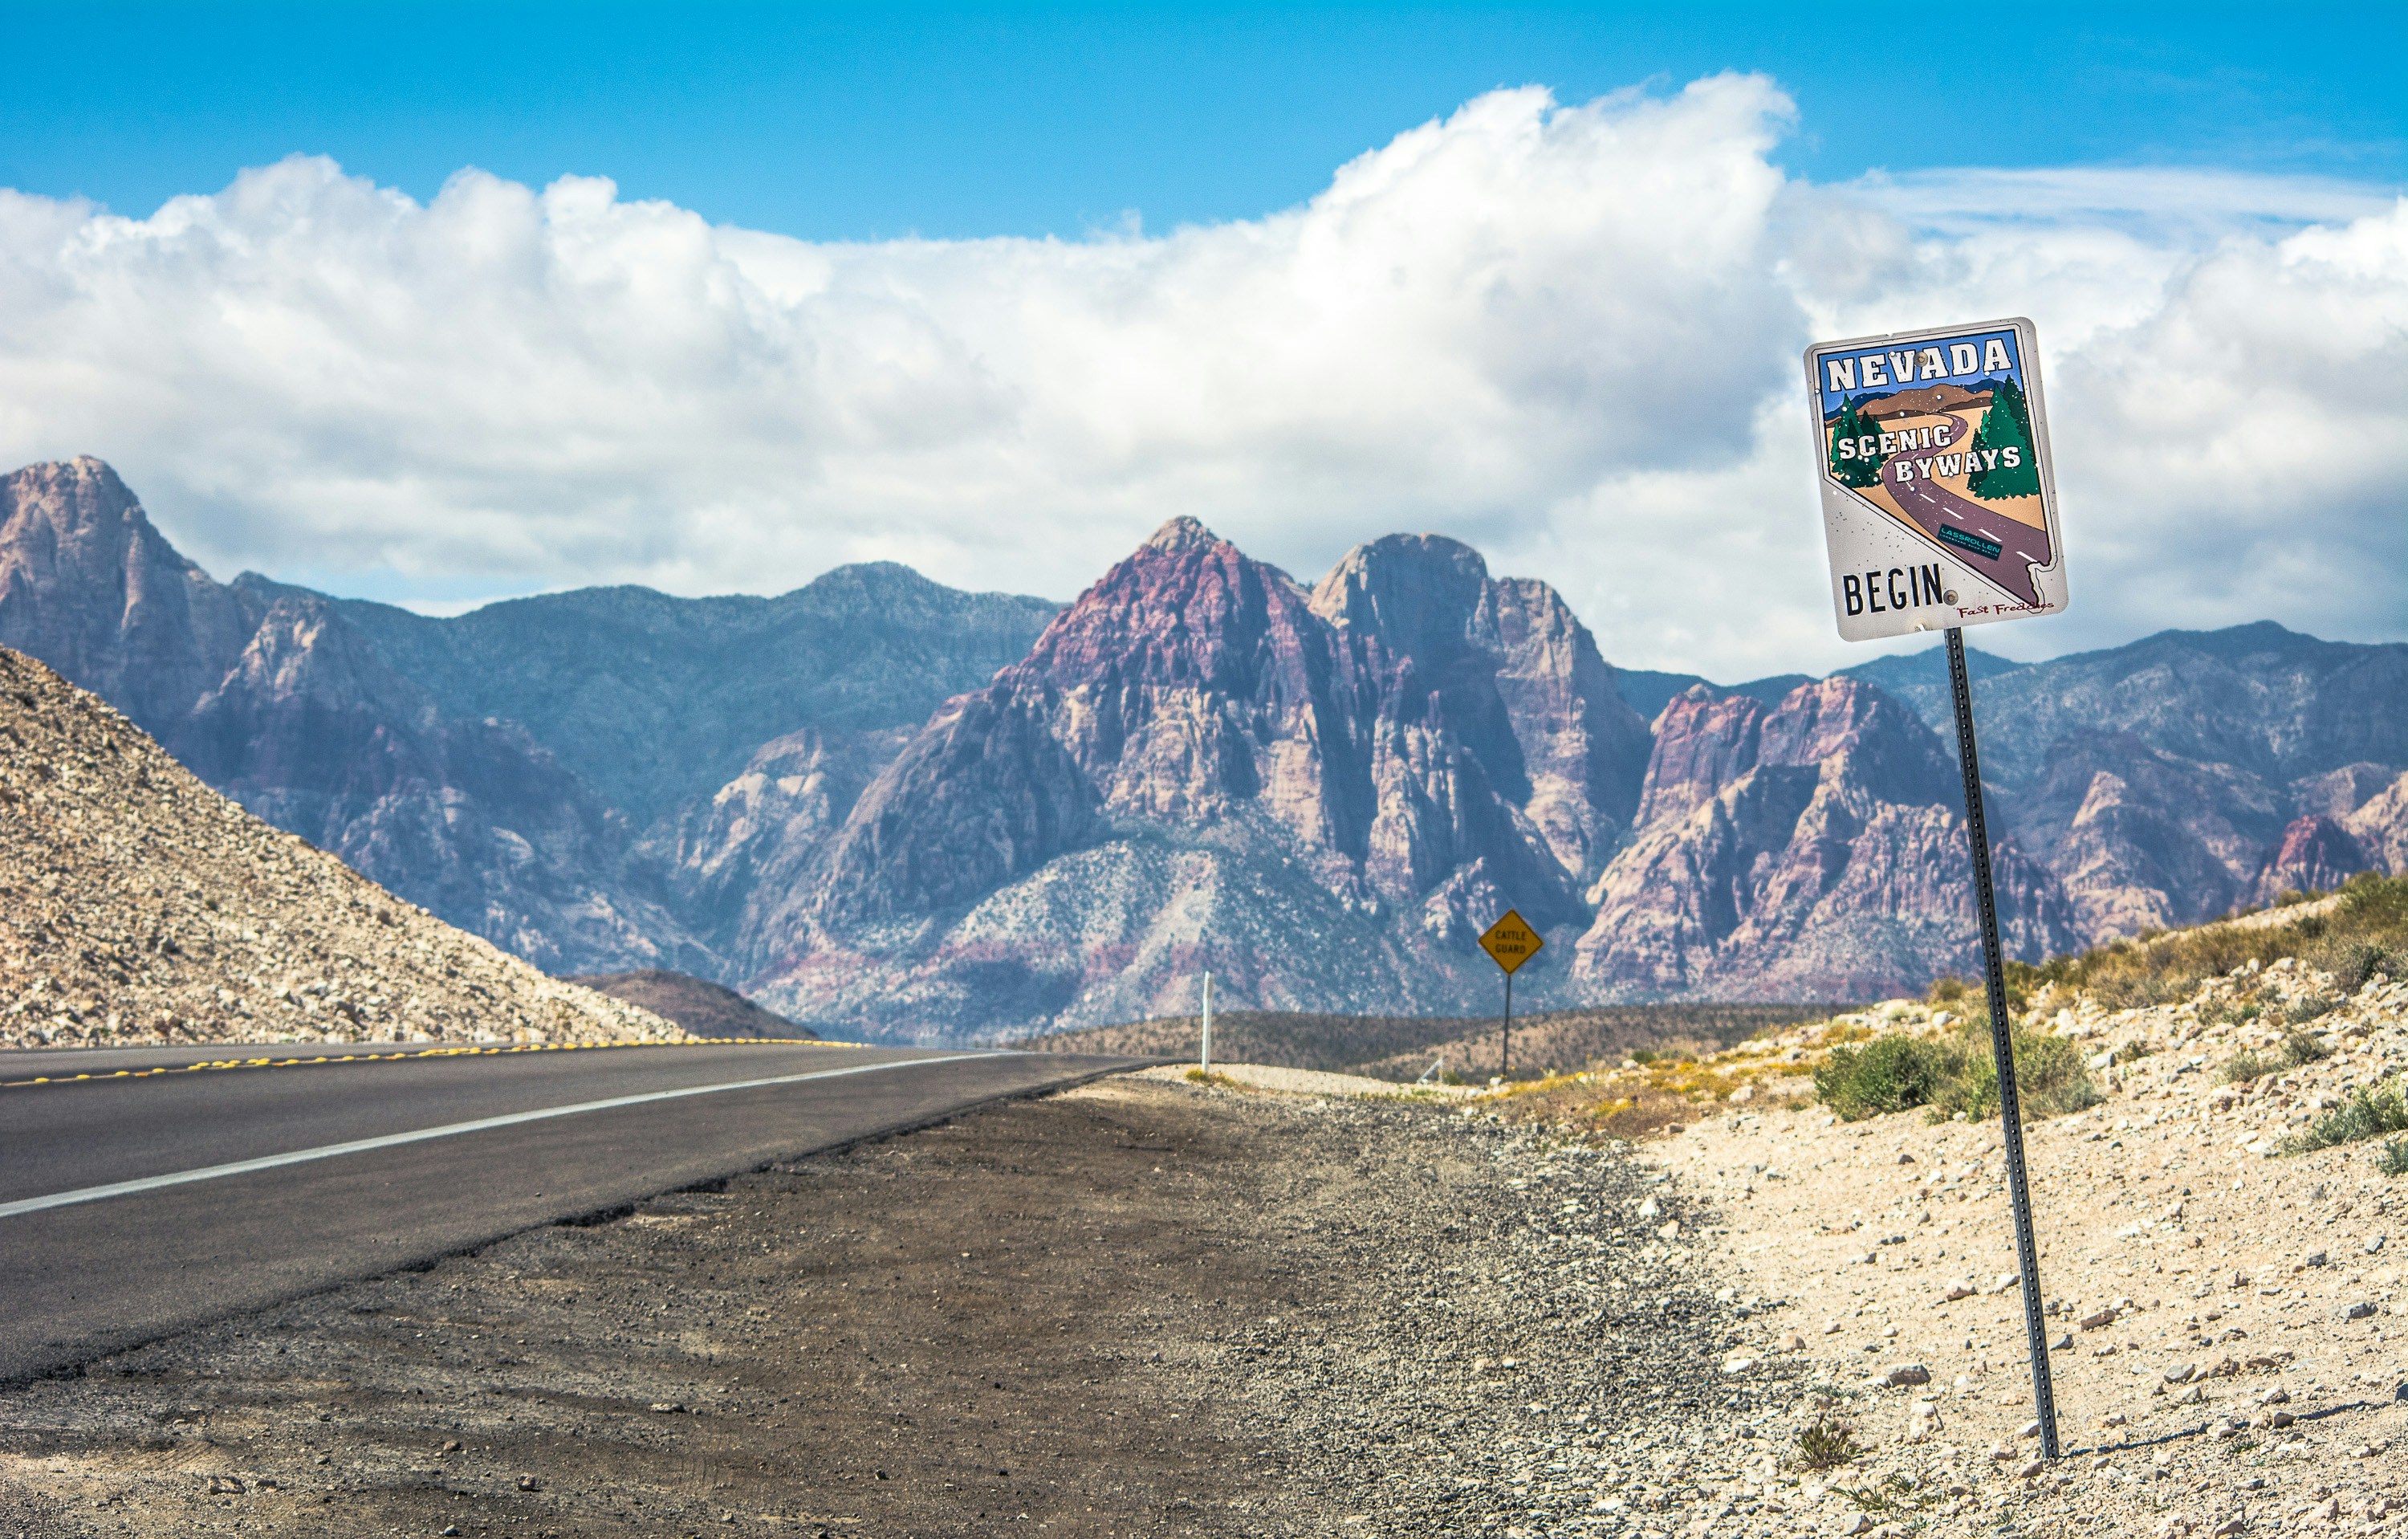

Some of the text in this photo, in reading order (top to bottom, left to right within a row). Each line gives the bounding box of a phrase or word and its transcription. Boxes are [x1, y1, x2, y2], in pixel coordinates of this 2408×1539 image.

[1827, 339, 2012, 392] NEVADA
[1838, 425, 1951, 458] SCENIC
[1894, 446, 2020, 482] BYWAYS
[1941, 527, 2000, 553] LASSROLLEN
[1843, 563, 1943, 616] BEGIN
[1495, 930, 1526, 940] CATTLE
[1495, 944, 1526, 954] GUARD
